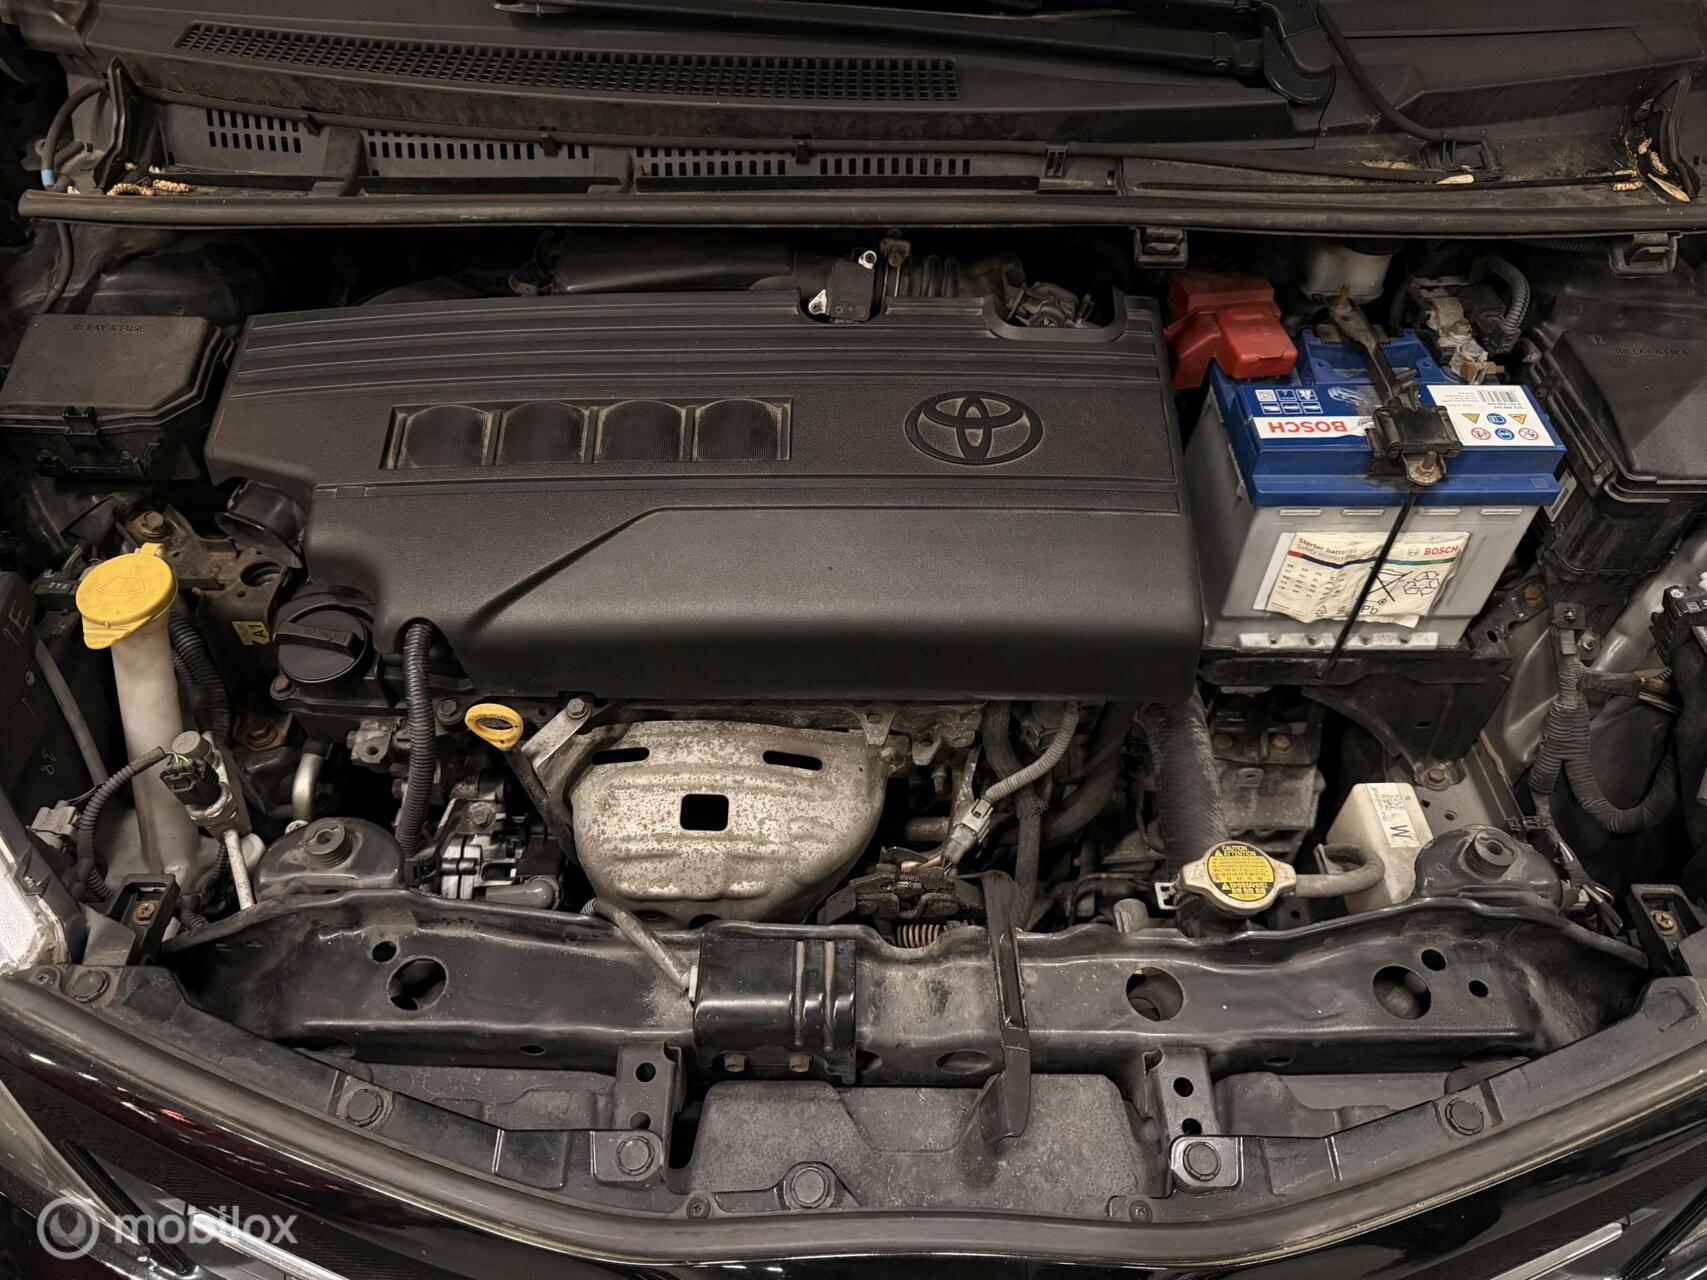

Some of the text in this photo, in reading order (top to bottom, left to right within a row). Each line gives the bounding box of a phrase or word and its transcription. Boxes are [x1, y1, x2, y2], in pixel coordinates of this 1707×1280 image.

[1268, 421, 1348, 433] BOSCH
[1298, 537, 1358, 555] Starter batteries
[1424, 545, 1459, 556] BOSCH
[1361, 604, 1379, 615] Pb
